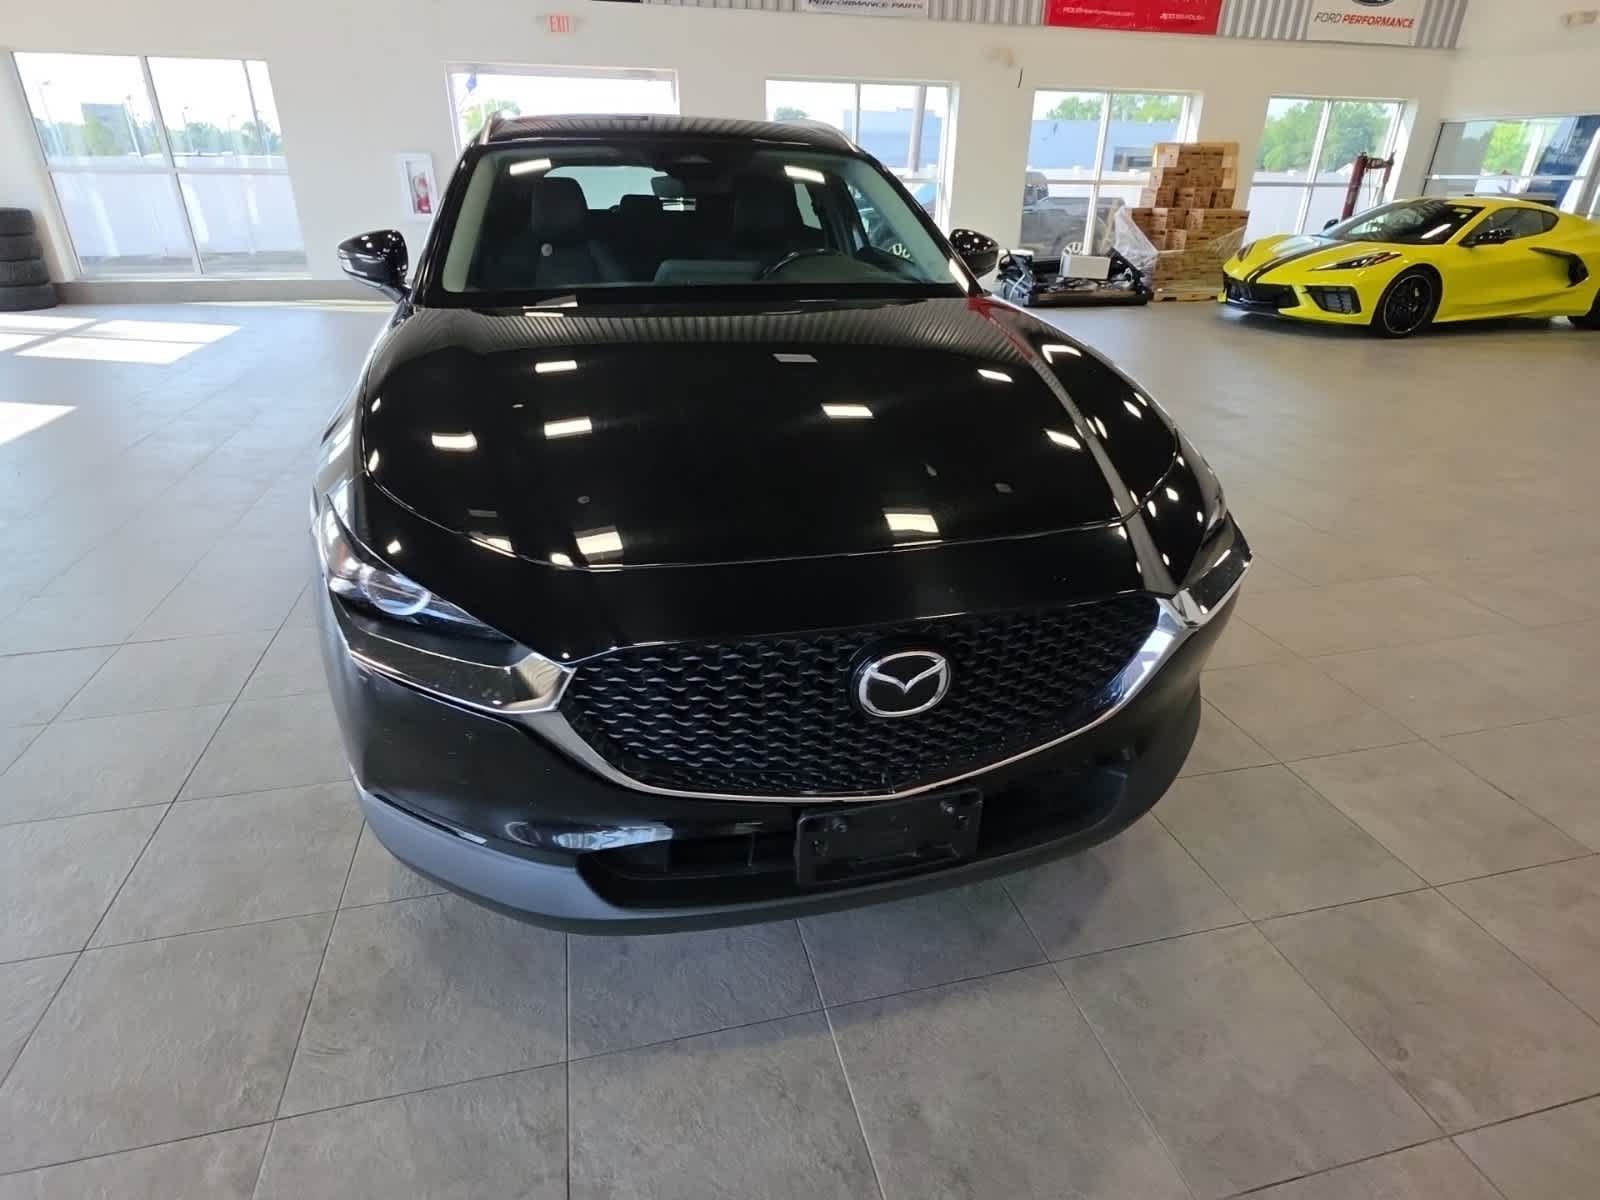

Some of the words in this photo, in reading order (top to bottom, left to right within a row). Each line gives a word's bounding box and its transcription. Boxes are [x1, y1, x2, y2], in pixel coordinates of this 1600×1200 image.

[550, 15, 570, 32] EXIT
[1315, 12, 1342, 24] FORD
[1343, 14, 1414, 28] PERFORMANCE
